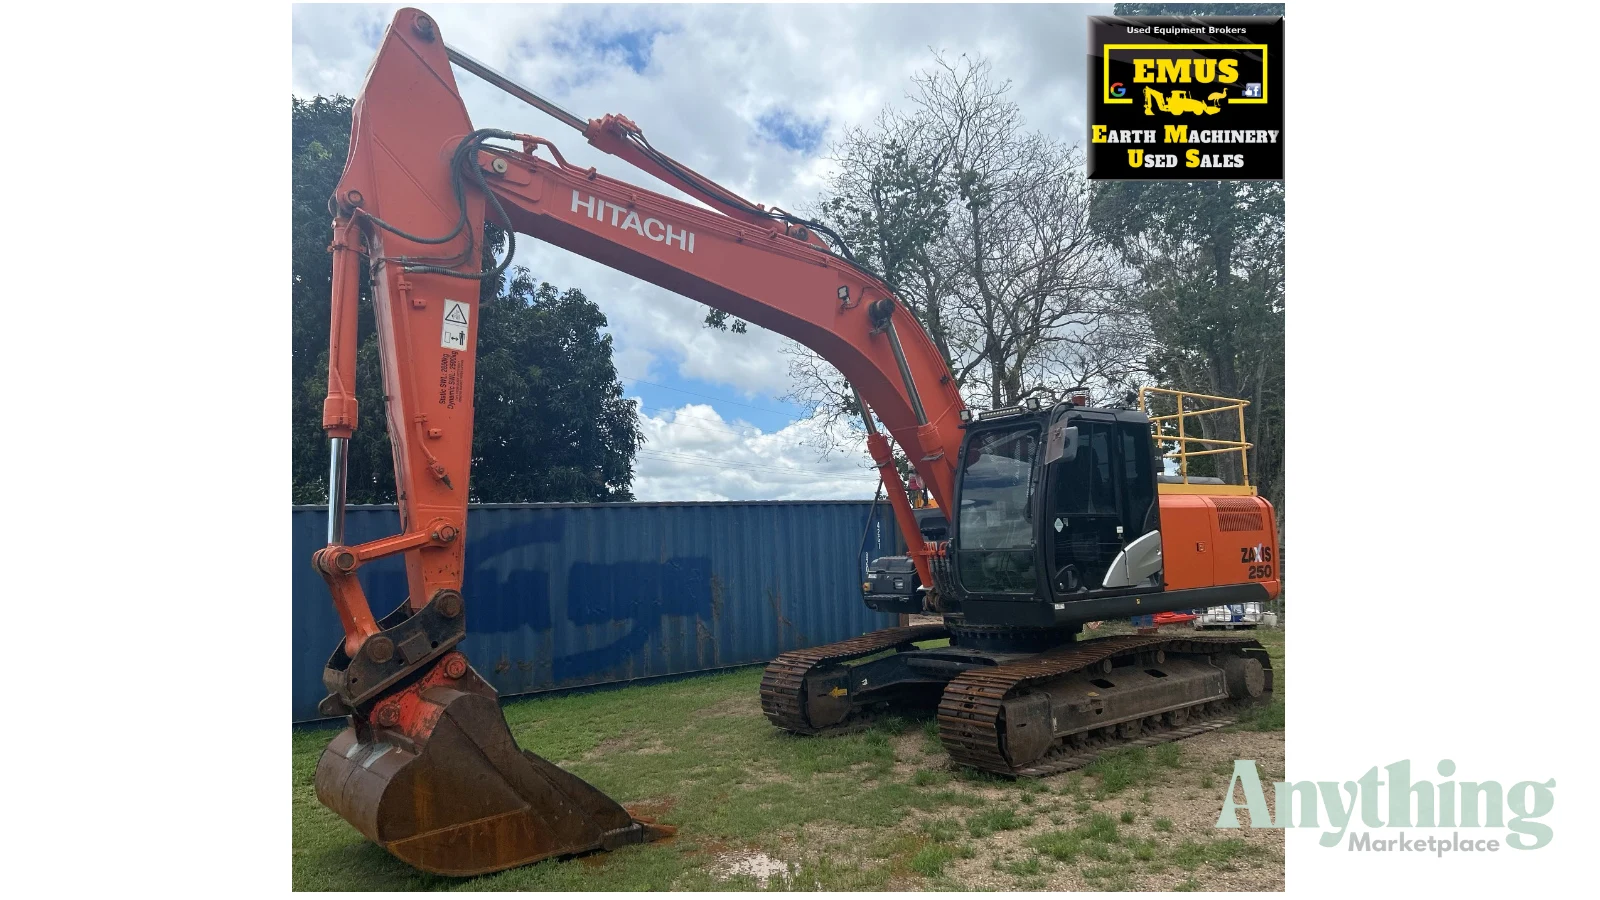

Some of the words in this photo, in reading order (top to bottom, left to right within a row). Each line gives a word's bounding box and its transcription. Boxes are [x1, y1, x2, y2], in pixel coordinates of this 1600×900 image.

[570, 189, 695, 254] HITACHI
[438, 388, 447, 405] Static
[447, 386, 456, 410] Dynamic
[1241, 543, 1272, 564] ZAXIS
[1248, 564, 1272, 580] 250
